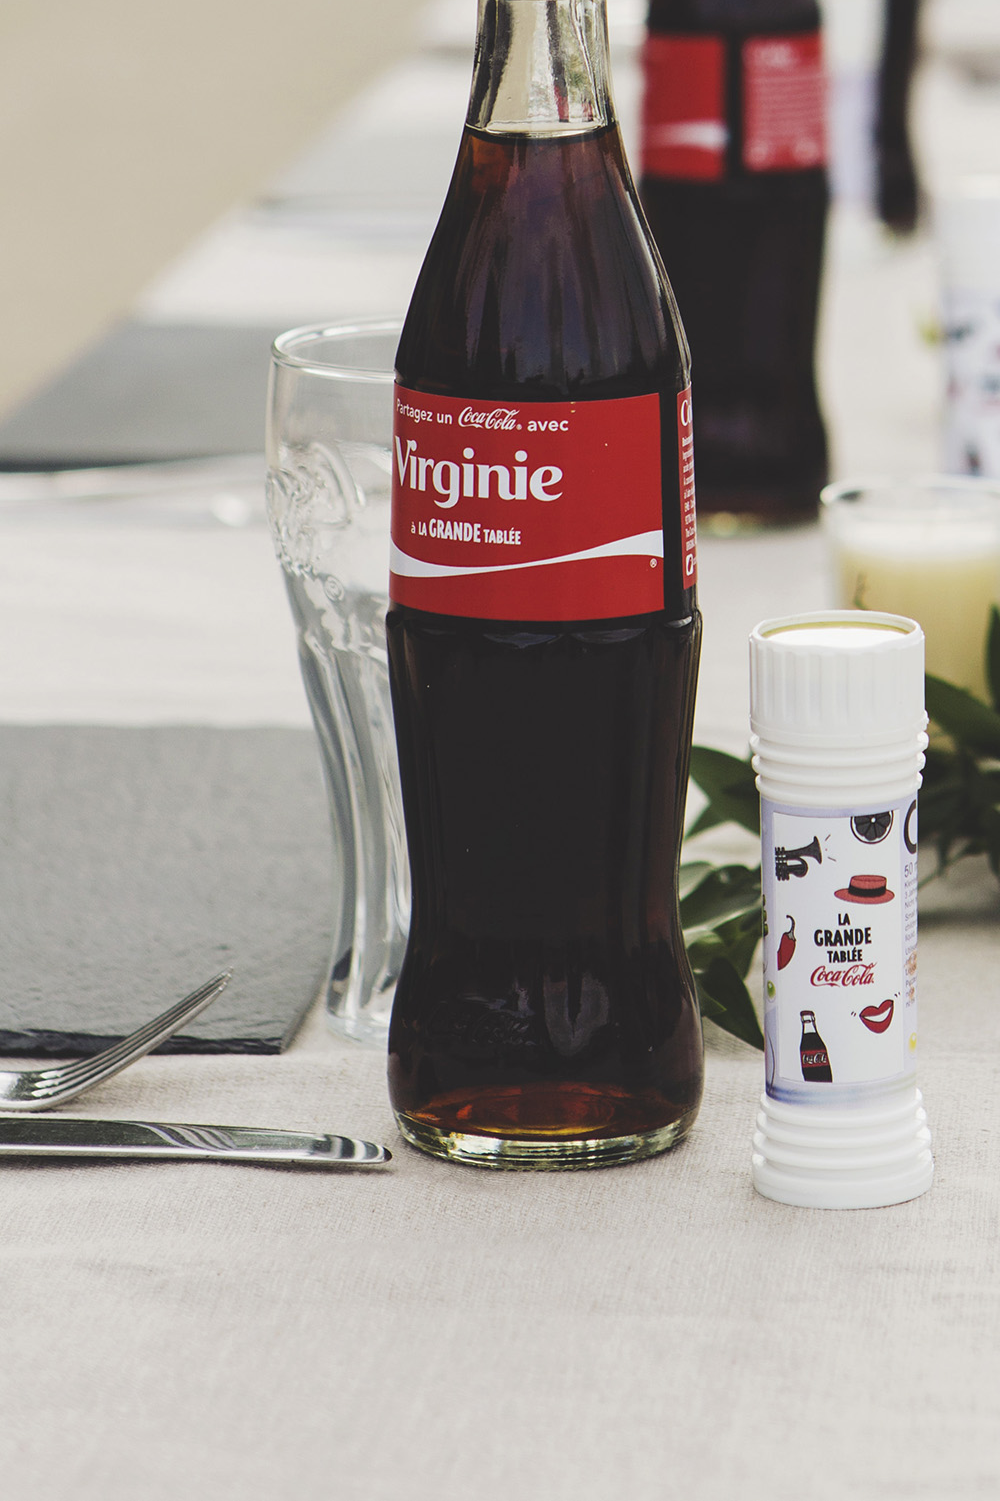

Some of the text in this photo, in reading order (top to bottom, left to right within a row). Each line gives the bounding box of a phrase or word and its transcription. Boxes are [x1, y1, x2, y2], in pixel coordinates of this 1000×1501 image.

[396, 398, 433, 423] Partagez
[436, 412, 453, 425] un
[527, 420, 569, 432] avec
[394, 435, 564, 509] Virginie
[410, 518, 521, 545] à LA GRANDE TABLÉE
[838, 913, 850, 926] LA
[814, 927, 872, 947] GRANDE
[827, 947, 863, 963] TABLÉE
[810, 962, 877, 987] Coca-Cola
